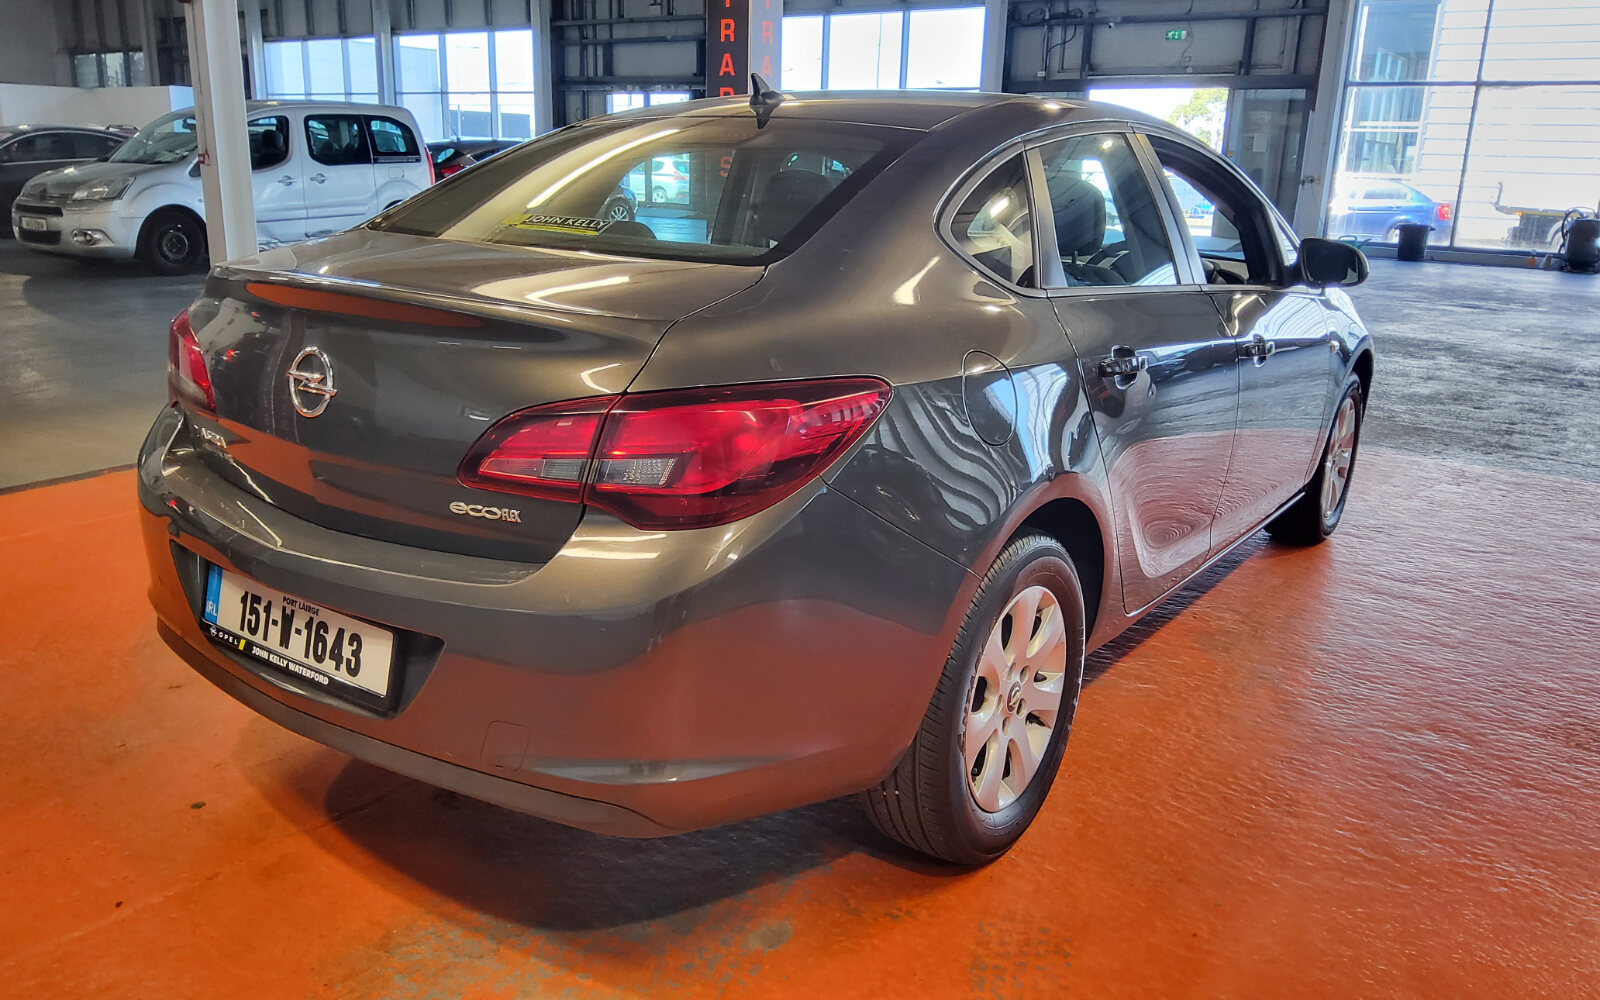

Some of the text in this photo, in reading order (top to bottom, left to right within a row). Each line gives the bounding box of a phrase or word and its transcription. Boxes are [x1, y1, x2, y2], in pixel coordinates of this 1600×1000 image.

[526, 214, 564, 224] JOHN
[565, 218, 609, 229] KELLY
[206, 600, 218, 616] IRL
[282, 596, 298, 608] PORT
[218, 631, 238, 645] OPEL
[239, 590, 362, 678] 151-W-1643
[252, 646, 329, 685] JOHN KELLY WATERFORD
